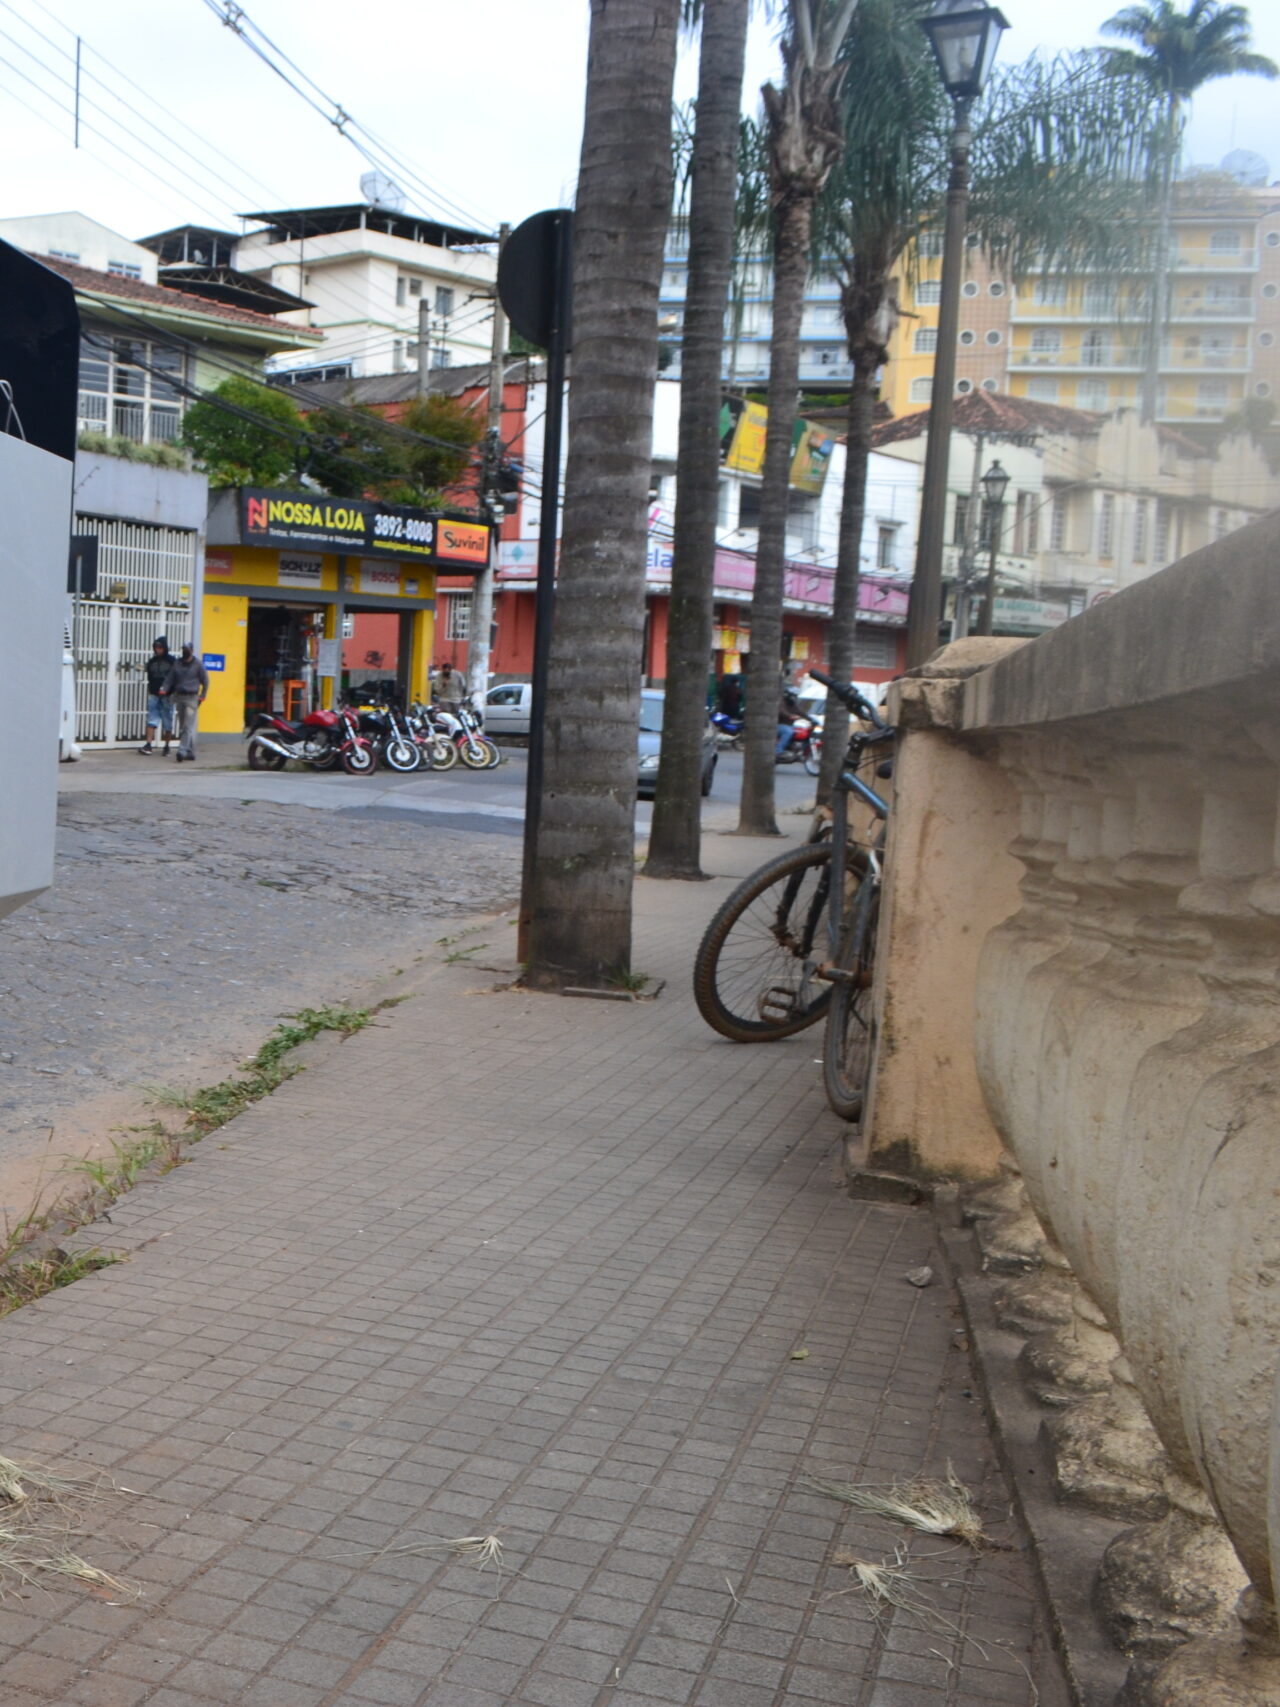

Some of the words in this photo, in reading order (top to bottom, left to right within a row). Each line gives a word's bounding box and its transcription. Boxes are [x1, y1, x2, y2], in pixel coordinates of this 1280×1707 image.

[269, 500, 323, 527] NOSSA
[325, 506, 366, 532] LOJA
[374, 513, 433, 542] 3892-8008
[443, 530, 485, 551] Suvinil
[279, 560, 322, 573] SCHULZ
[371, 571, 400, 583] BOSCH
